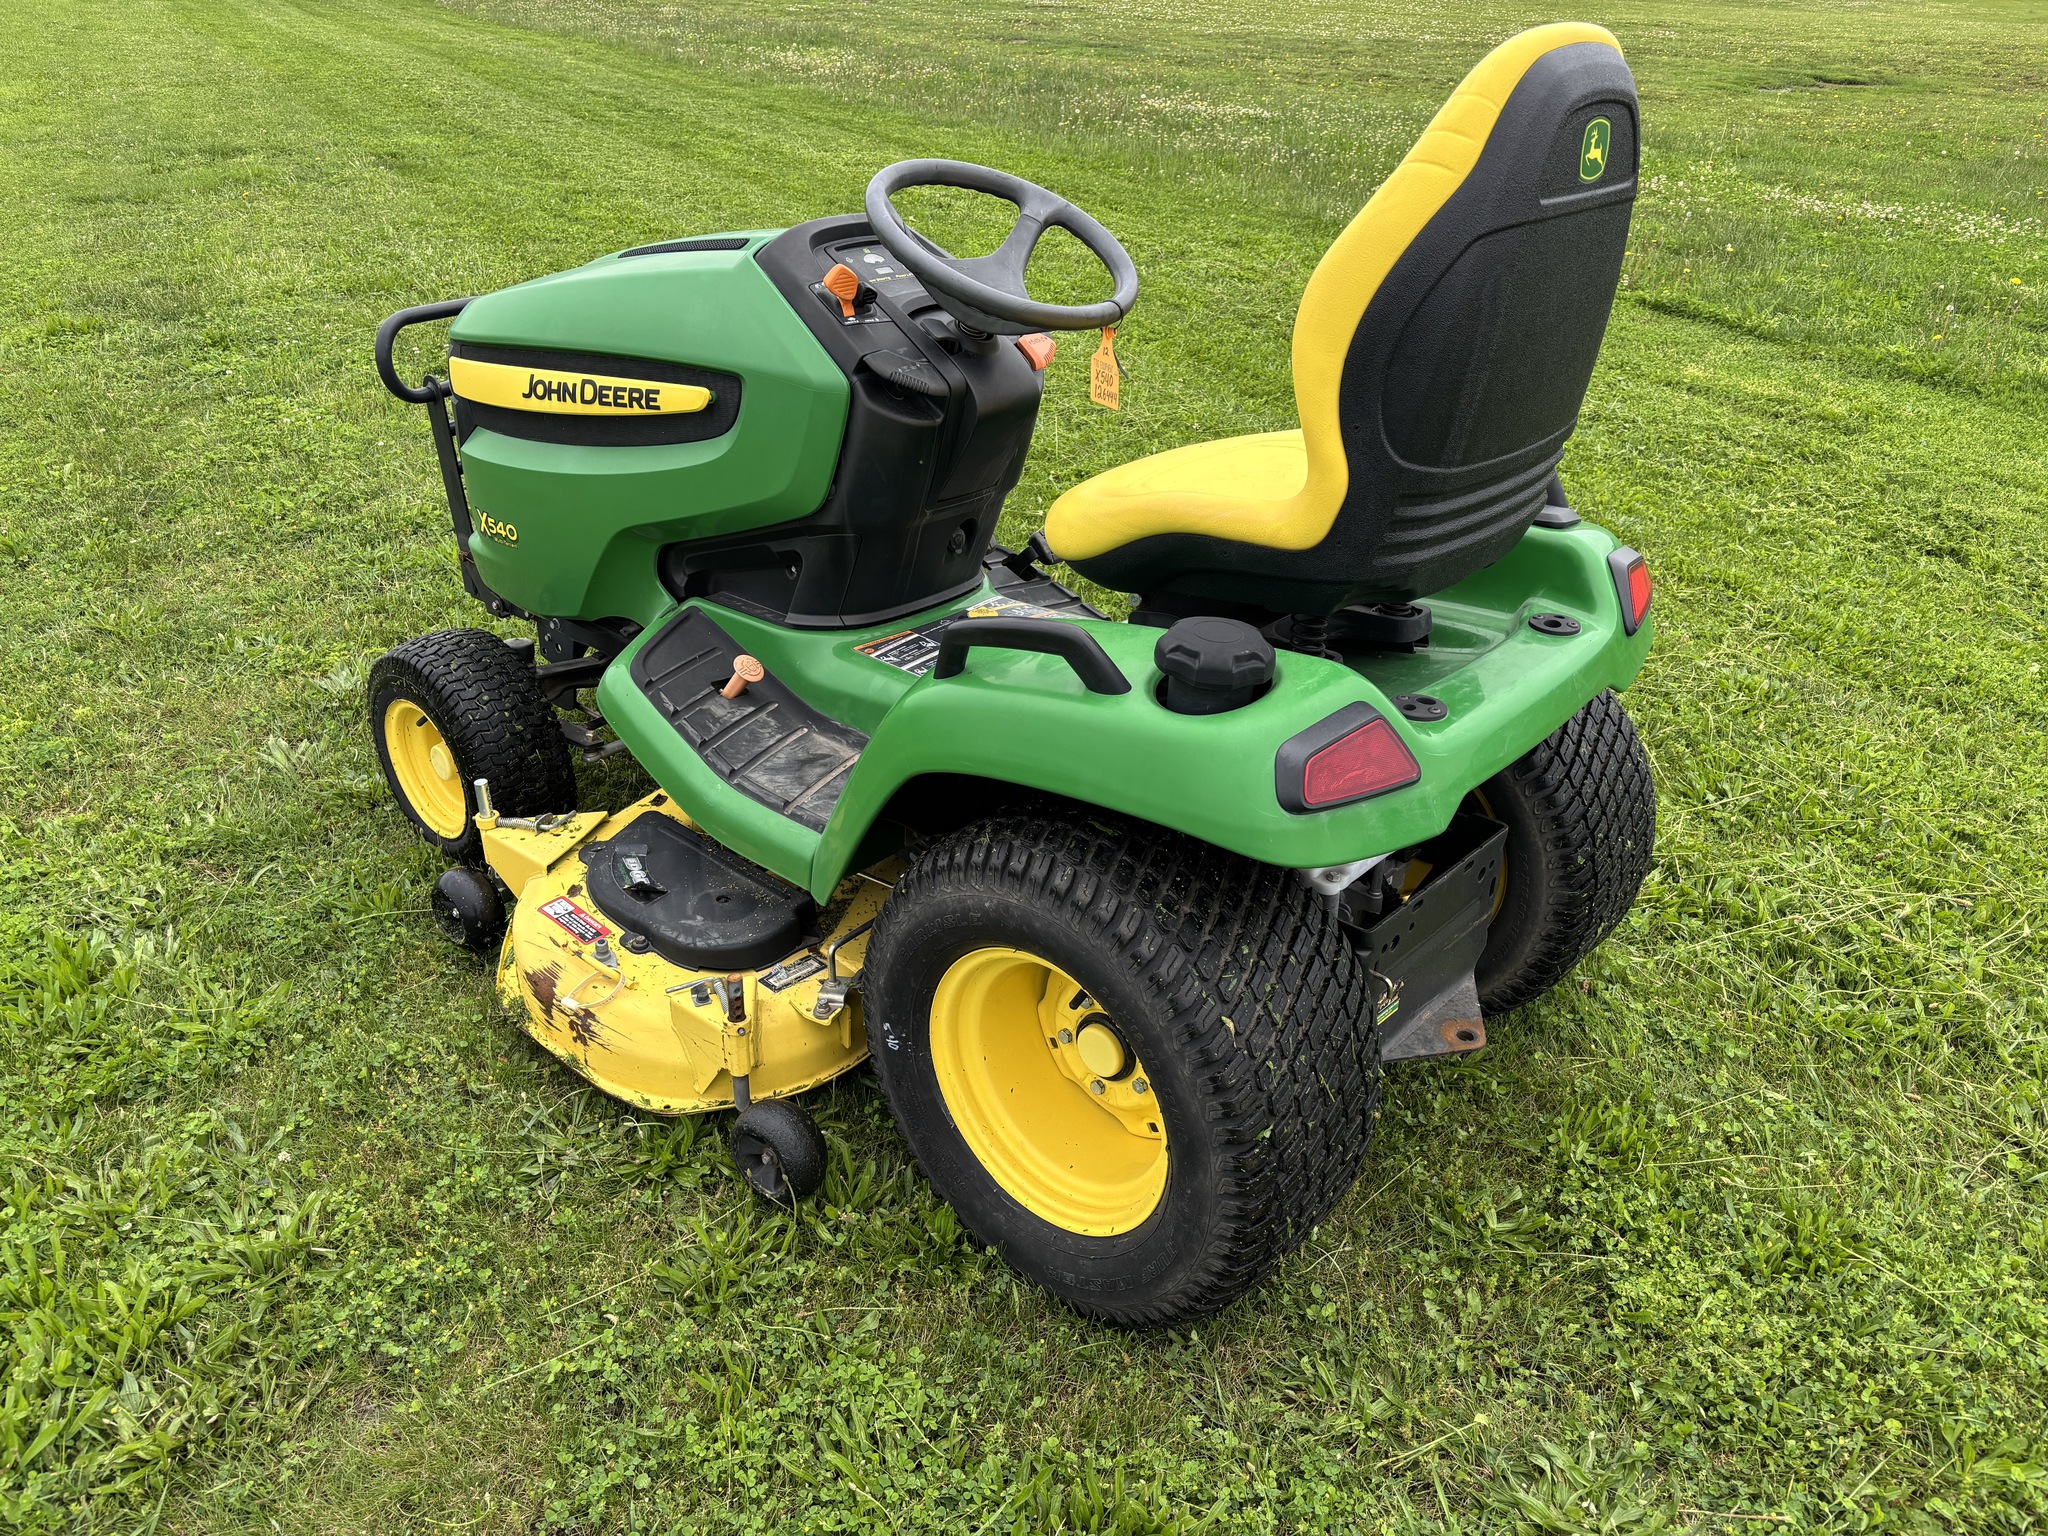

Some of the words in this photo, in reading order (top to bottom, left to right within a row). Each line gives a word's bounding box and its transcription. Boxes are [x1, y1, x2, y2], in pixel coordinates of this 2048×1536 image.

[1102, 346, 1109, 357] 12
[1095, 369, 1114, 387] X540
[522, 374, 577, 404] JOHN
[580, 378, 661, 410] DEERE
[476, 508, 518, 541] X540
[583, 915, 602, 929] DANGER
[898, 912, 982, 966] CARLISLE
